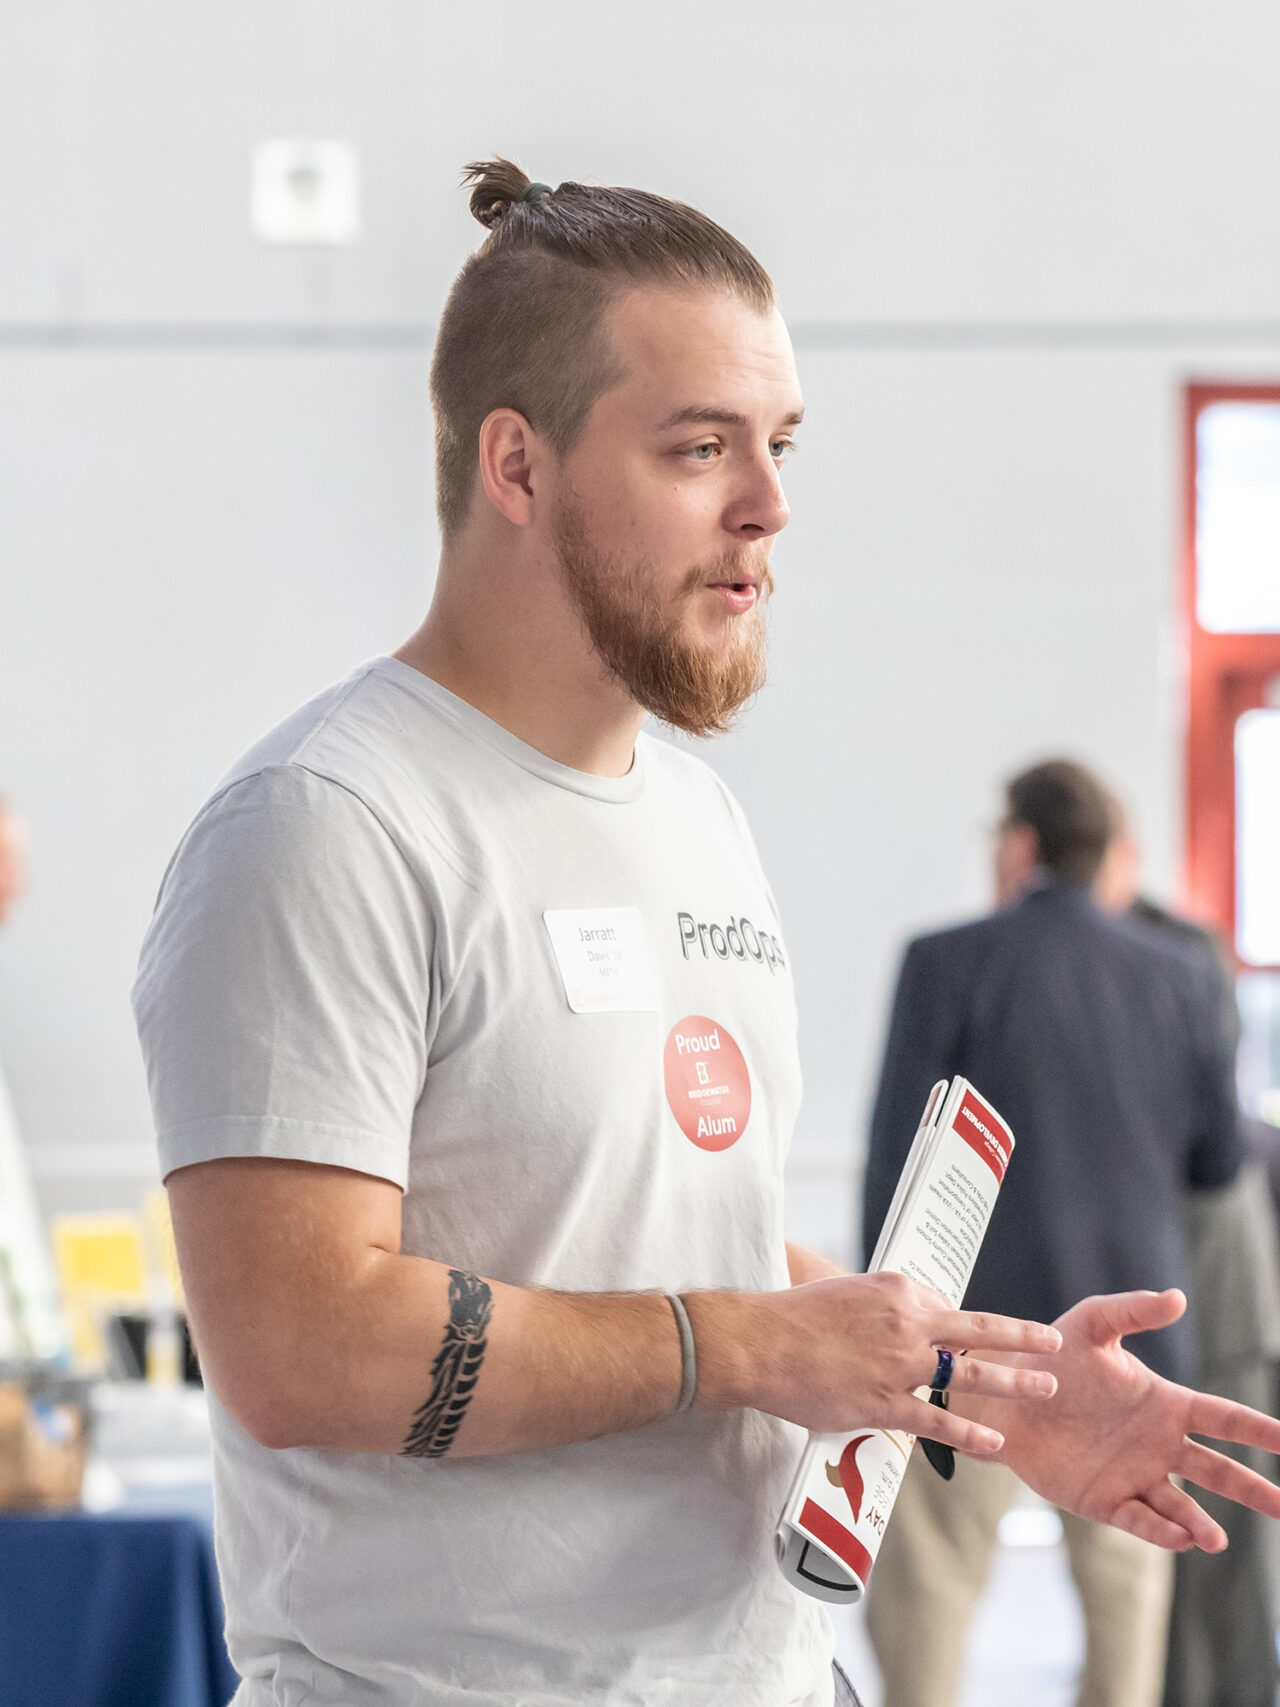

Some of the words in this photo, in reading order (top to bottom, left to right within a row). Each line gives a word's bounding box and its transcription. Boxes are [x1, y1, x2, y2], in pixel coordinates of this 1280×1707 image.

[579, 927, 616, 942] Jarratt
[677, 912, 786, 976] ProdOps
[675, 1028, 721, 1055] Proud
[695, 1061, 711, 1085] B
[697, 1114, 737, 1138] Alum
[961, 1105, 999, 1149] DEVELOPMENT
